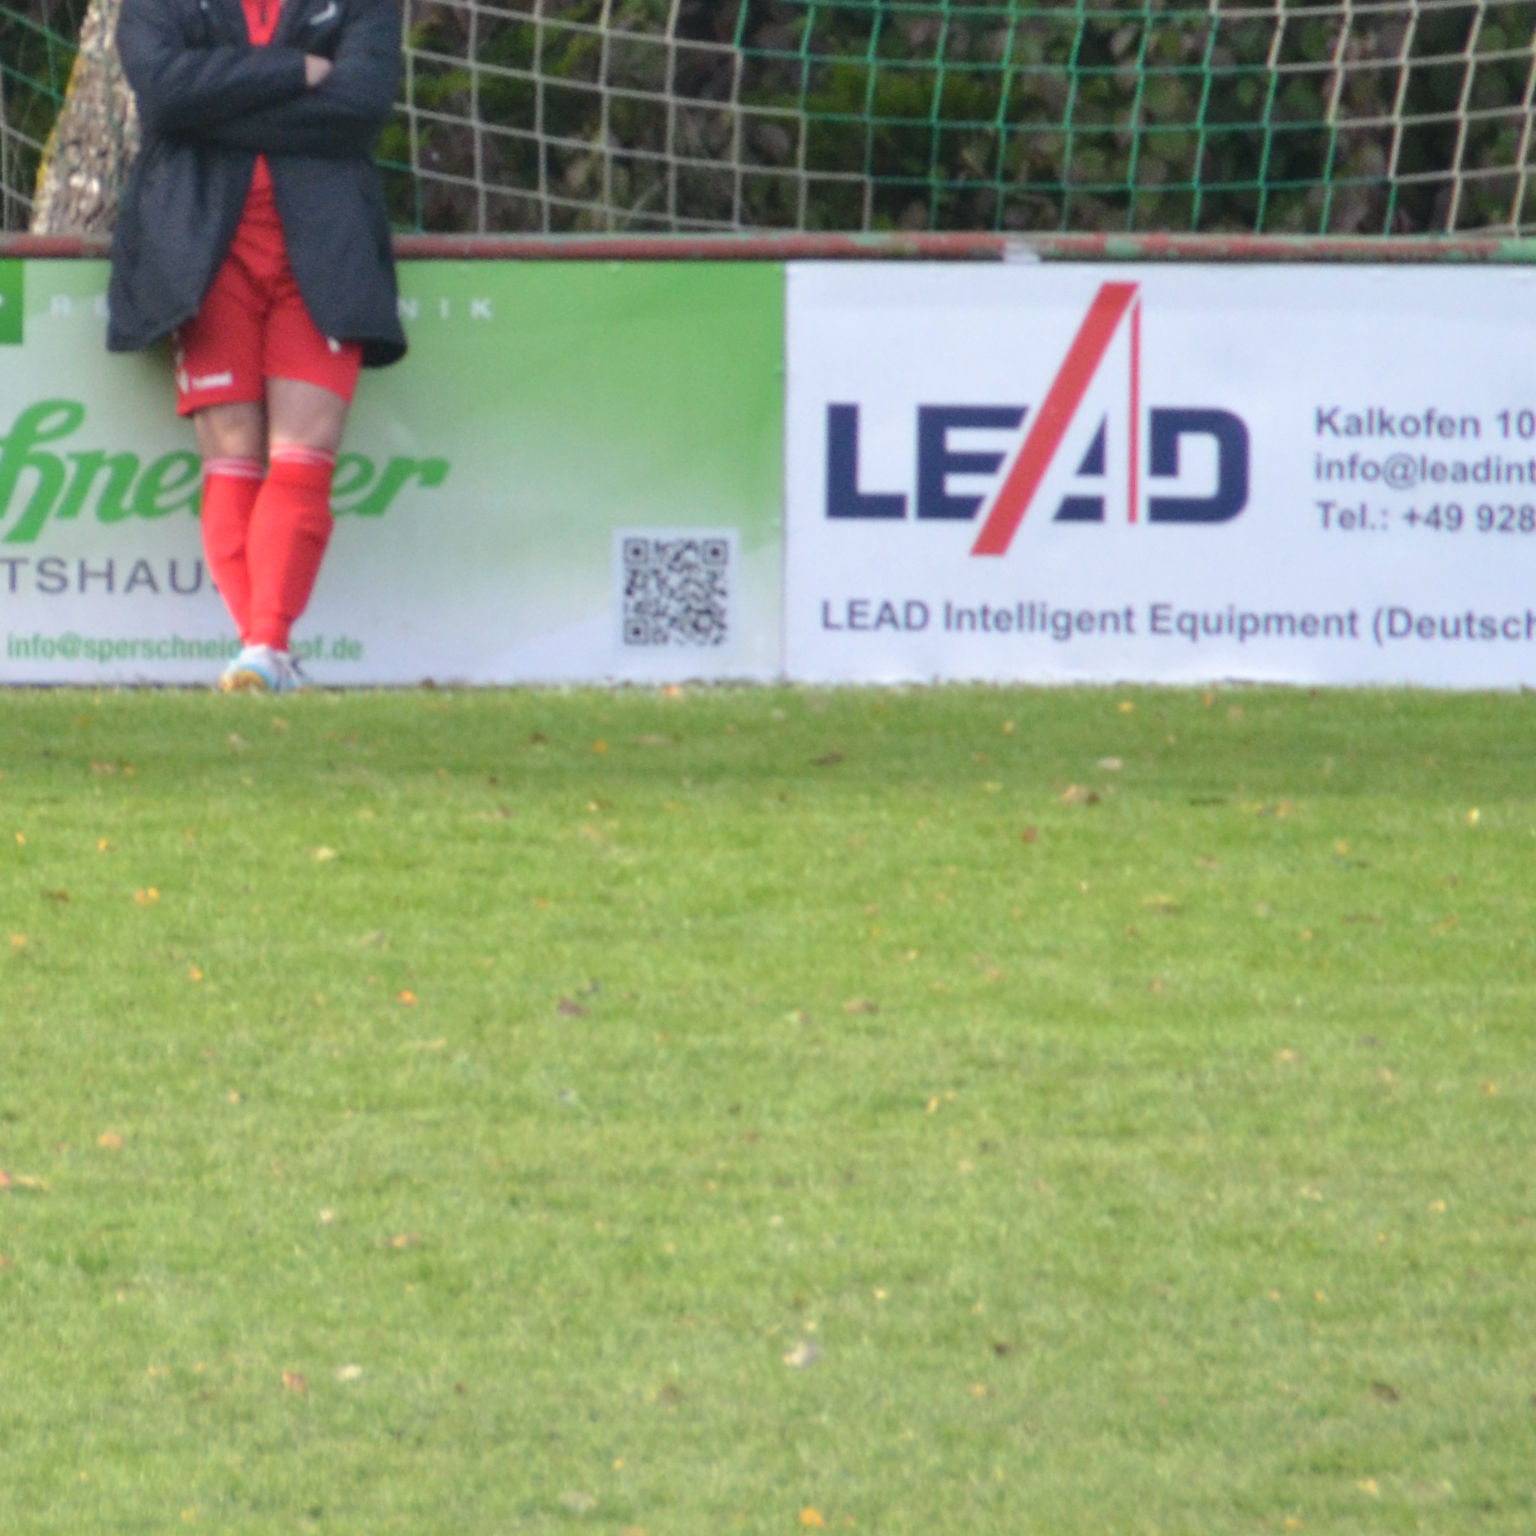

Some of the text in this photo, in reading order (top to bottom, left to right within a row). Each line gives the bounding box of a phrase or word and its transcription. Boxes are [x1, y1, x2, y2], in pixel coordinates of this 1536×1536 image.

[825, 281, 1250, 555] LEAD
[1315, 405, 1481, 439] Kalkofen
[1316, 499, 1390, 532] Tel.:
[1403, 503, 1463, 533] +49
[822, 600, 930, 632] LEAD
[944, 601, 1136, 641] Intelligent
[1150, 604, 1359, 642] Equipment
